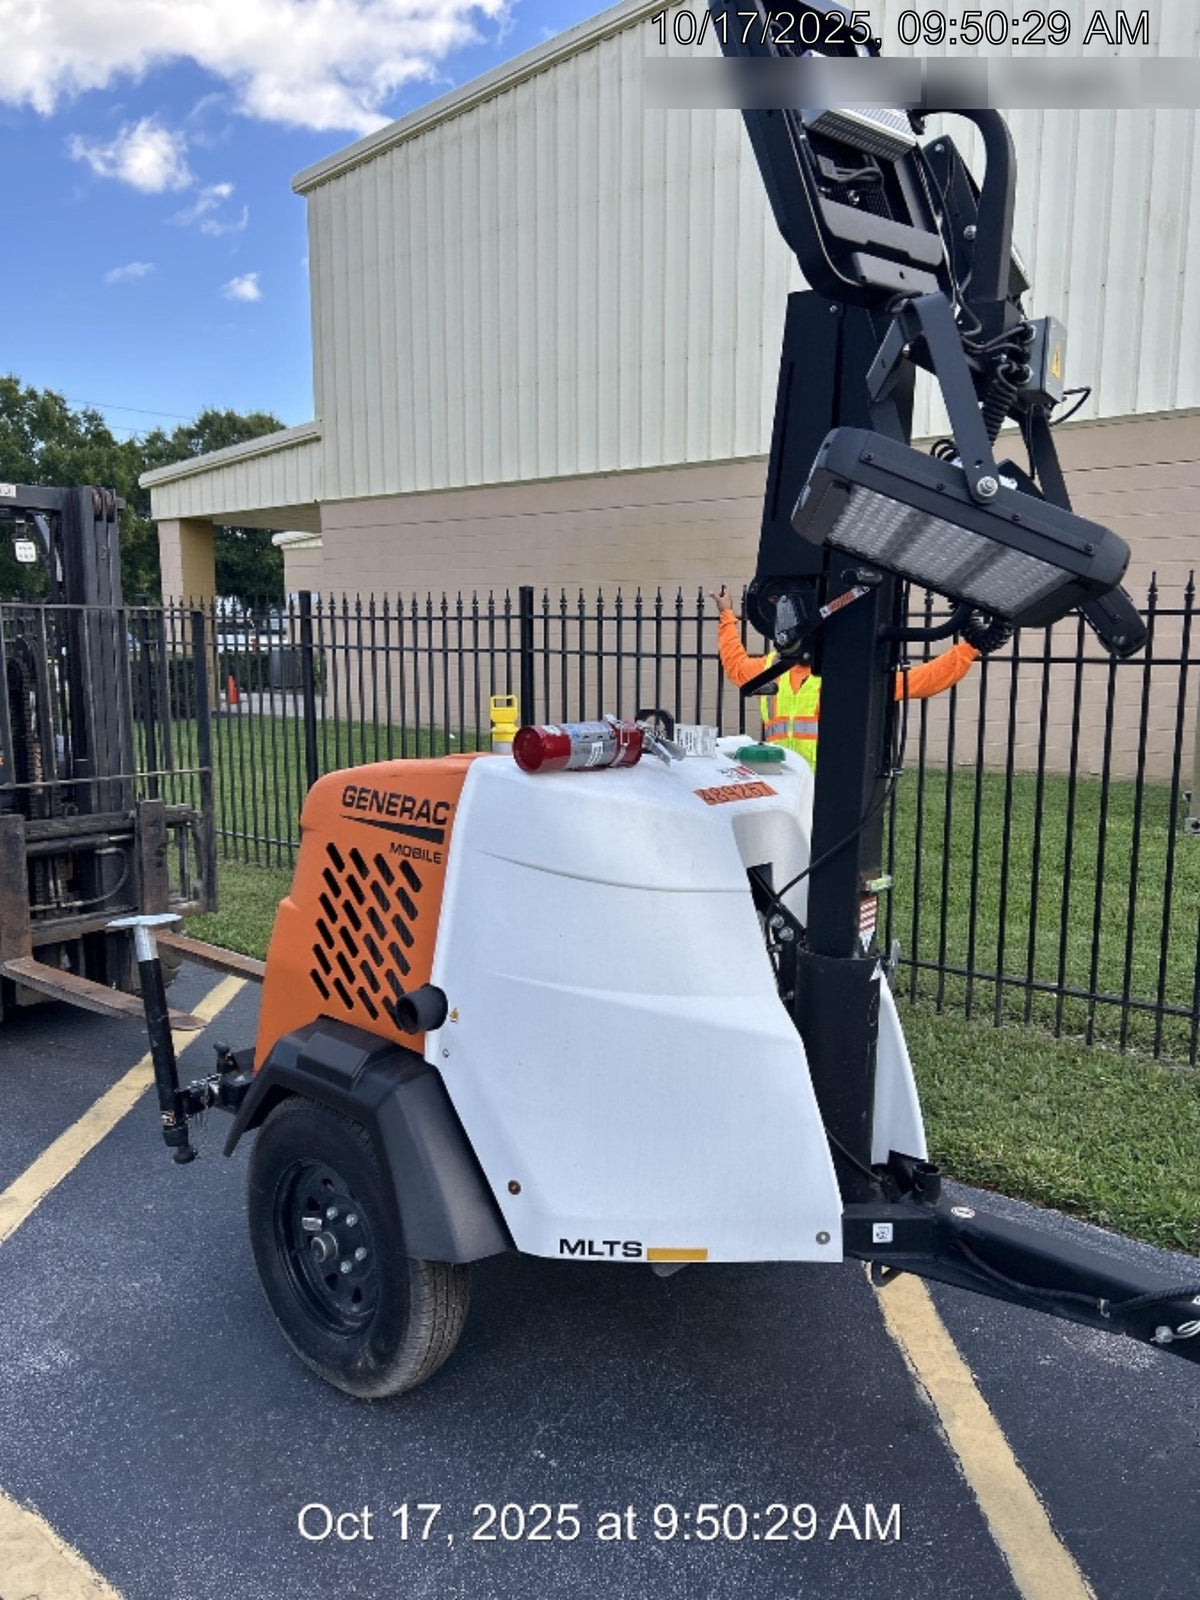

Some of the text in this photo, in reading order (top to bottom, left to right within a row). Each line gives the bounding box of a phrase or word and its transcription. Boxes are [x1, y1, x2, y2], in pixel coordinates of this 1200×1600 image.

[342, 785, 450, 825] GENERAC
[389, 842, 443, 864] MOBILE
[559, 1238, 643, 1257] MLTS
